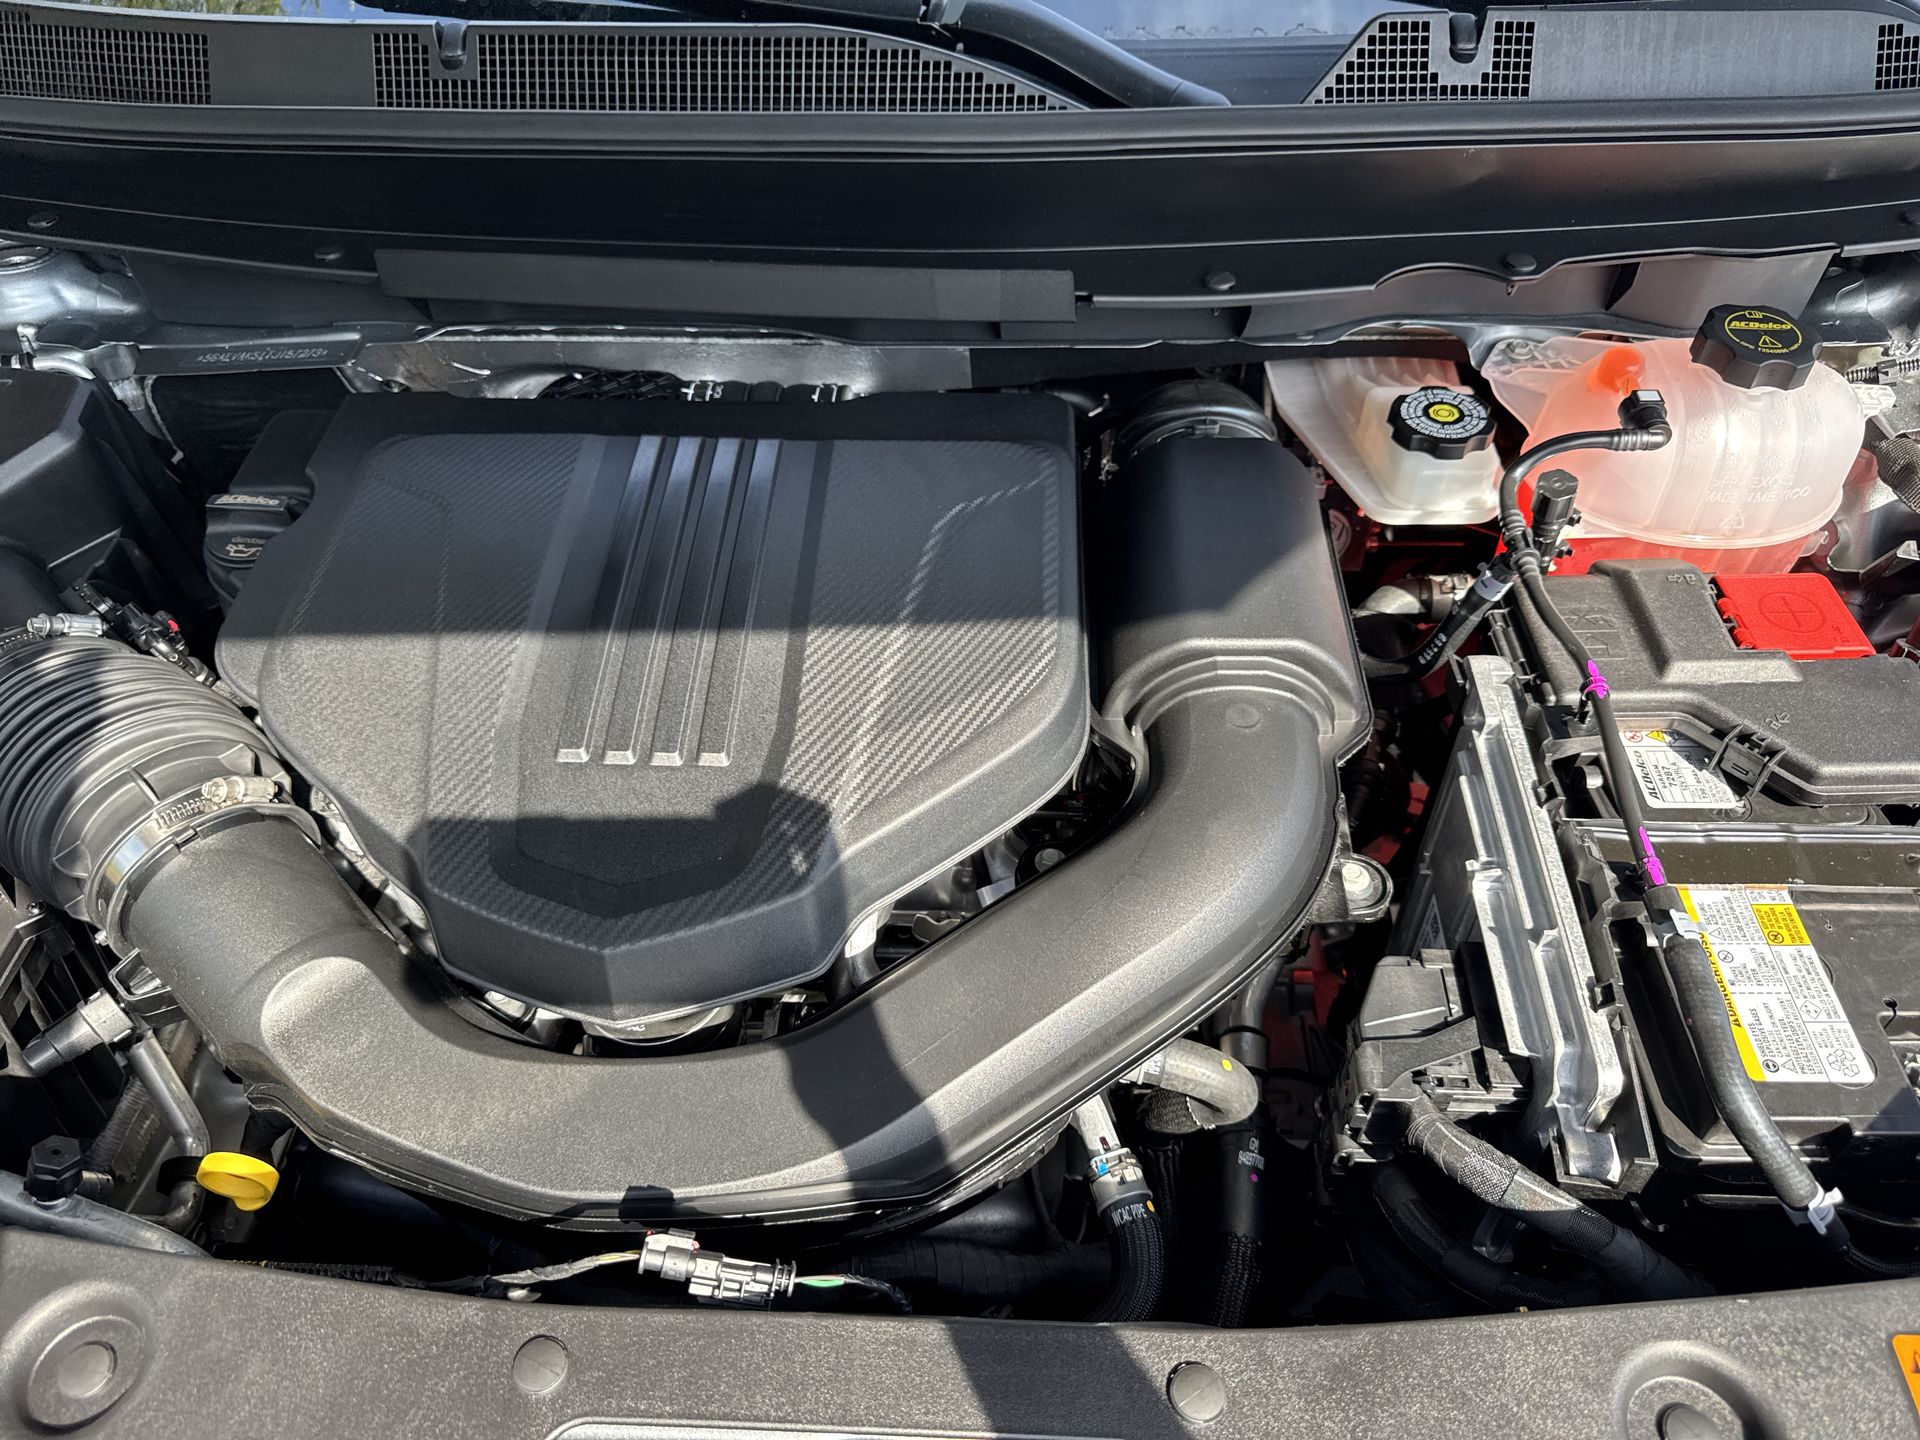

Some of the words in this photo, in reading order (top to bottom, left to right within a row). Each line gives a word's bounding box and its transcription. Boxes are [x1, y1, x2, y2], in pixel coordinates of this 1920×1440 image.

[1730, 320, 1792, 330] ACDelco
[214, 494, 280, 506] ACDelco
[1754, 486, 1811, 504] MEICO
[1634, 750, 1660, 799] ACDelco
[1660, 766, 1678, 787] 7287
[1669, 761, 1683, 778] VRLA
[1678, 780, 1688, 790] 12V
[1696, 902, 1712, 925] SULFURIC
[1756, 1027, 1776, 1057] EXPLOSIVE
[1110, 1204, 1132, 1228] WCAC
[1131, 1203, 1148, 1219] PIPE
